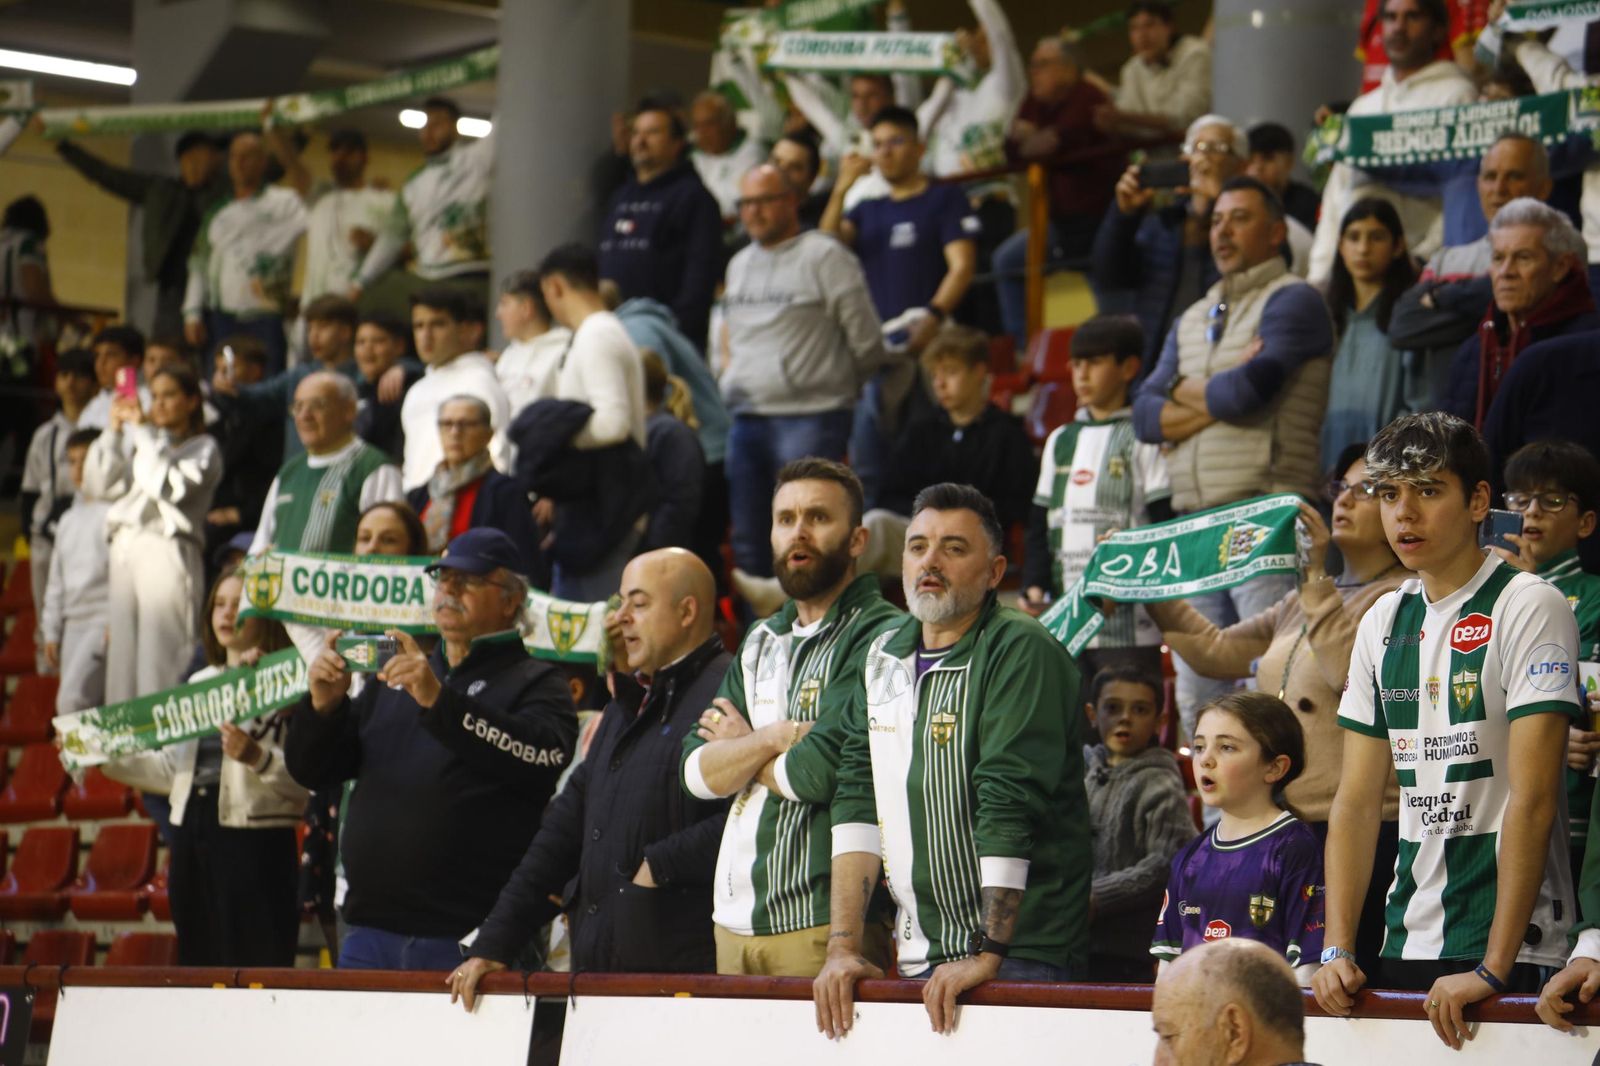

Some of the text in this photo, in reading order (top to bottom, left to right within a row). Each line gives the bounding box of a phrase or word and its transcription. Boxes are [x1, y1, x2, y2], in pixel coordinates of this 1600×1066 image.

[291, 563, 425, 606] CÓRDOBA
[1453, 622, 1490, 643] Deza
[255, 656, 309, 710] FUTSA
[1393, 752, 1418, 762] ÓRDOBA
